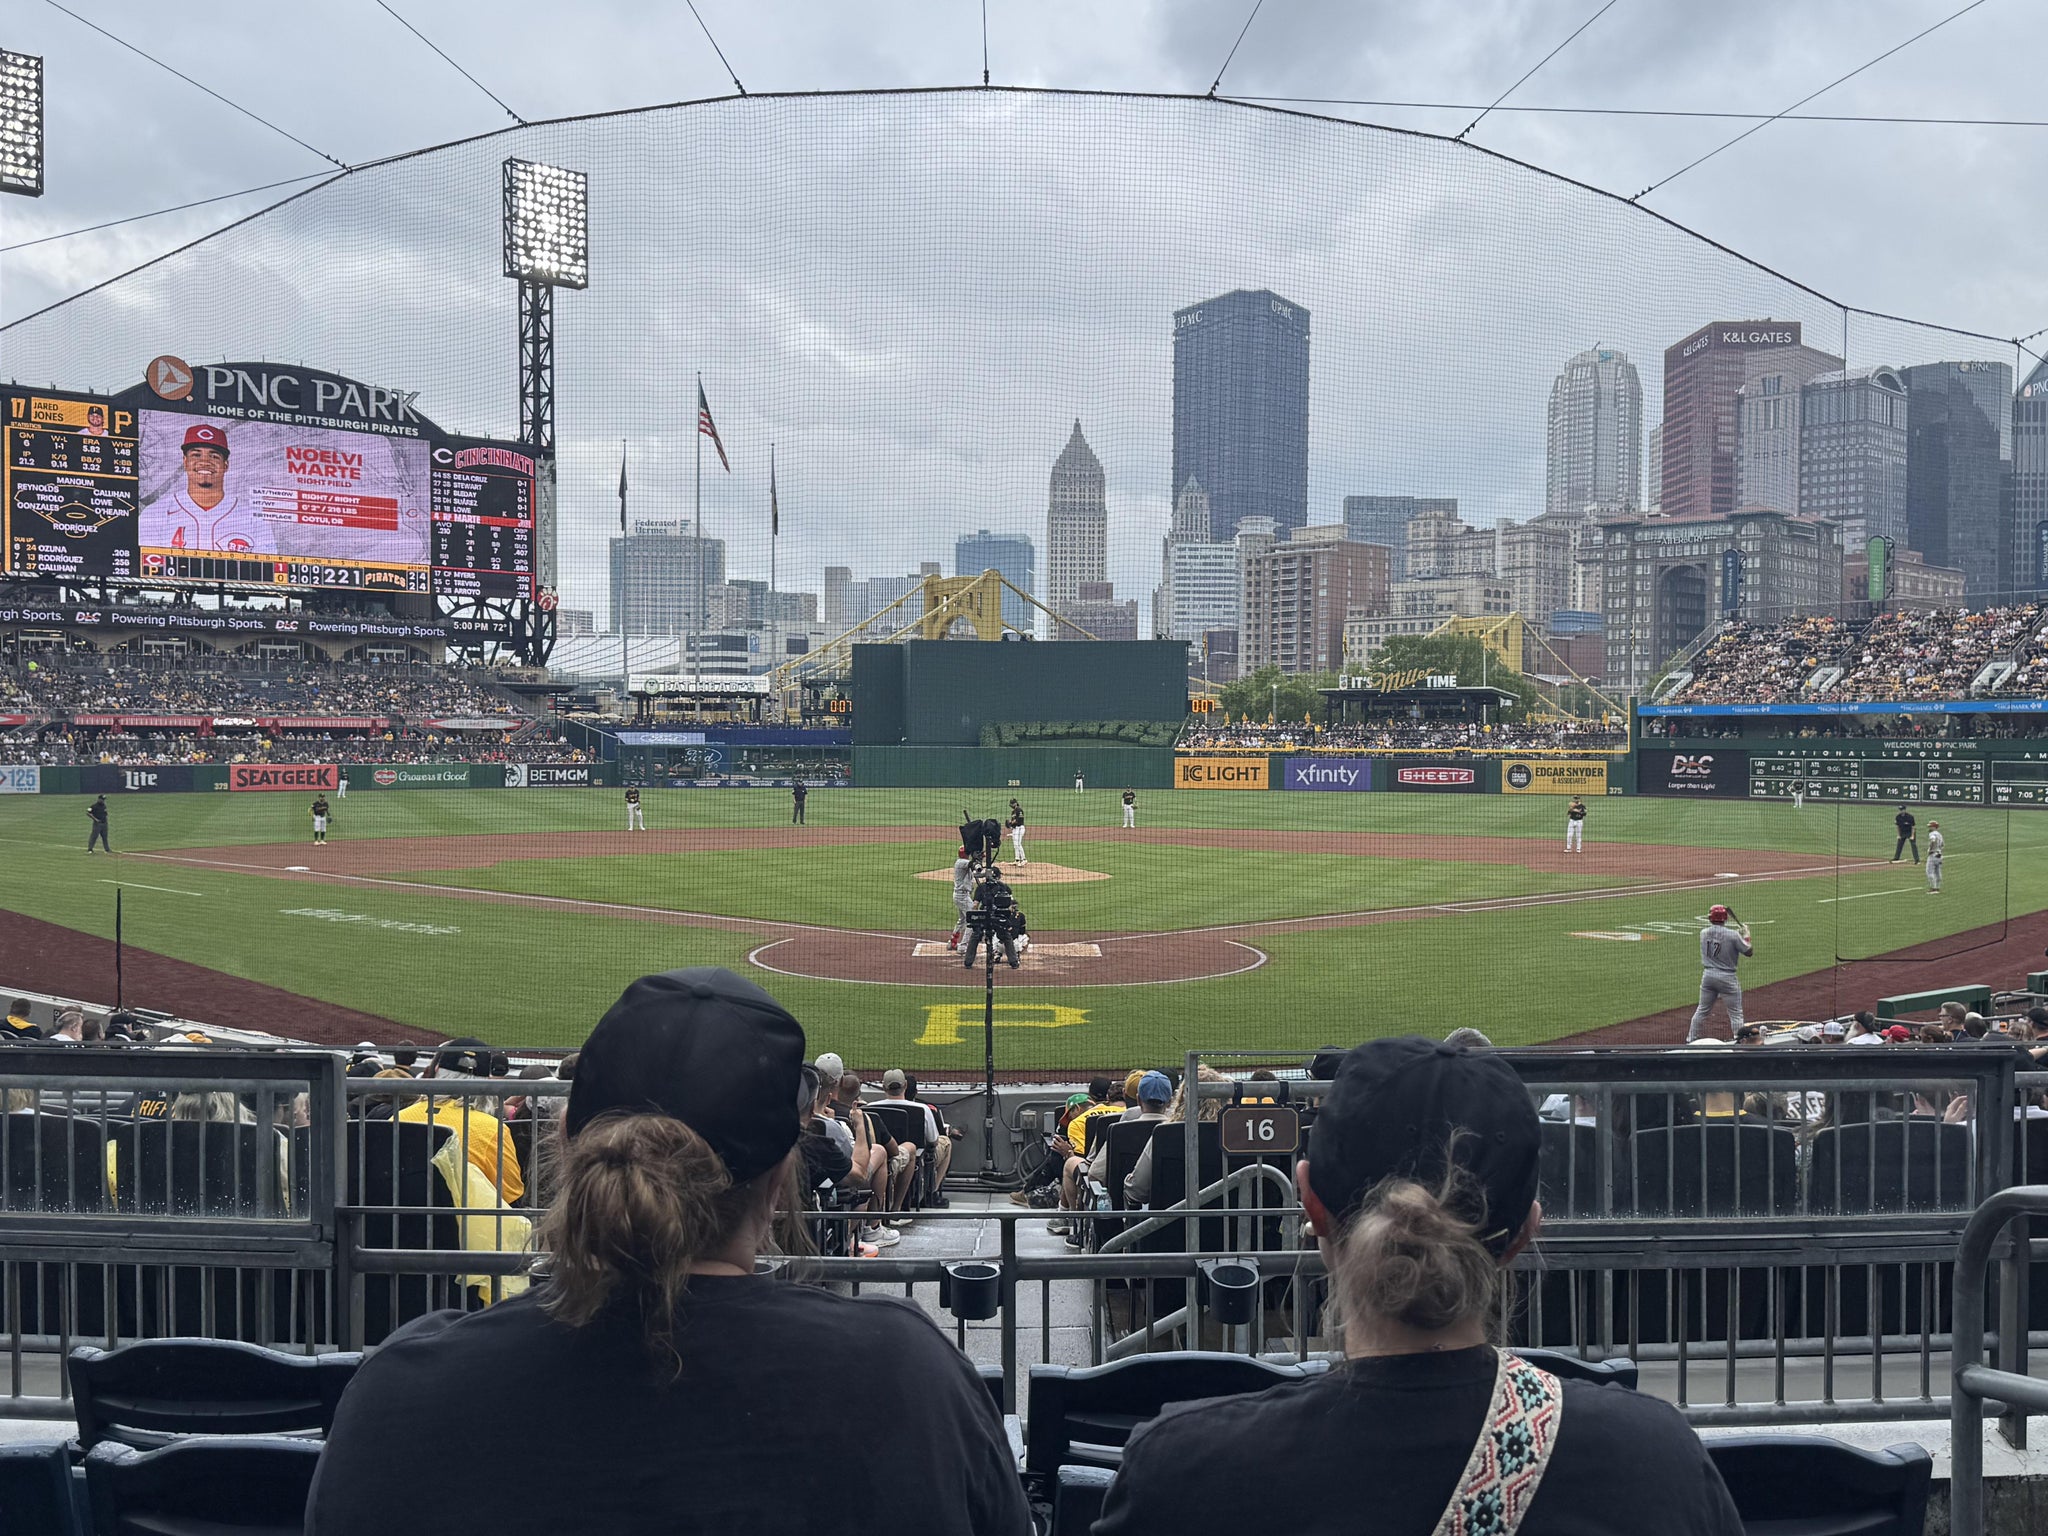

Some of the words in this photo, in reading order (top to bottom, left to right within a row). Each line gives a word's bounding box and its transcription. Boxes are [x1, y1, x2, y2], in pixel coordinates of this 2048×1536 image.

[1272, 300, 1294, 320] UPMC
[1174, 310, 1203, 330] UPMC
[1692, 334, 1709, 352] GATES
[1723, 332, 1747, 343] K&L
[1749, 332, 1792, 343] GATES
[203, 365, 300, 409] PNC
[311, 379, 420, 424] PARK
[11, 398, 25, 418] 17
[34, 402, 59, 411] JARED
[33, 411, 64, 421] JONES
[208, 404, 244, 416] HOME
[248, 409, 264, 418] OF
[268, 412, 292, 422] THE
[295, 414, 368, 431] PITTSBURGH
[372, 423, 419, 436] PIRATES
[285, 447, 362, 466] NOELVI
[455, 447, 534, 476] CINCINNATI
[288, 464, 361, 480] MARTE
[57, 477, 94, 486] MANGUM
[297, 477, 326, 486] RIGHT
[328, 480, 352, 488] FIELD
[453, 482, 482, 490] STEWART
[17, 483, 59, 492] REYNOLDS
[37, 494, 64, 502] TRIOLO
[93, 490, 130, 498] CALLIHAN
[301, 492, 326, 502] RIGHT
[335, 496, 360, 504] RIGHT
[17, 502, 59, 511] GONZALES
[91, 498, 112, 506] LOWE
[95, 508, 129, 517] O'HEARN
[453, 506, 471, 514] LOWE
[454, 515, 481, 523] MARTE
[53, 522, 98, 533] RODRÍGUEZ
[38, 545, 67, 553] OZUNA
[38, 553, 84, 563] RODRÍGUEZ
[38, 564, 76, 572] CALLIHAN
[302, 565, 308, 574] 0
[168, 568, 176, 576] 0
[290, 574, 297, 583] 2
[302, 575, 308, 583] 0
[324, 568, 338, 584] 2
[338, 569, 351, 585] 2
[364, 571, 406, 587] PIRATES
[409, 572, 415, 580] 2
[419, 573, 426, 581] 4
[454, 571, 475, 579] MYERS
[409, 581, 415, 590] 2
[419, 582, 426, 591] 4
[454, 580, 480, 588] TREVINO
[454, 588, 480, 596] ARROYO
[22, 609, 65, 622] Sports.
[76, 612, 102, 622] DLC
[112, 613, 166, 627] Powering
[169, 616, 226, 630] Pittsburgh
[228, 618, 266, 630] Sports.
[276, 620, 299, 630] DLC
[454, 622, 472, 630] 5:00
[475, 622, 488, 630] PM
[493, 623, 508, 632] 72°
[309, 622, 358, 634] Powering
[360, 624, 411, 637] Pittsburgh
[414, 626, 448, 638] Sports.
[1351, 676, 1373, 688] IT'S
[1371, 667, 1436, 694] Miller
[1426, 675, 1457, 688] TIME
[664, 680, 690, 692] FAT
[696, 681, 756, 693] HEAD'S
[830, 700, 852, 712] 0:07
[1192, 700, 1215, 712] 0:07
[1671, 755, 1714, 774] DLC
[236, 768, 332, 788] SEATGEEK
[398, 771, 436, 782] Growers
[443, 771, 468, 781] Good
[530, 769, 588, 781] BETMGM
[1183, 766, 1202, 782] IC
[1207, 766, 1260, 781] LIGHT
[1296, 764, 1360, 786] xfinity
[1402, 771, 1468, 780] SHEETZ
[1536, 767, 1565, 776] EDGAR
[1566, 768, 1604, 778] SNYDER
[8, 769, 36, 788] 125
[125, 771, 158, 790] Lite
[1246, 1118, 1275, 1142] 16
